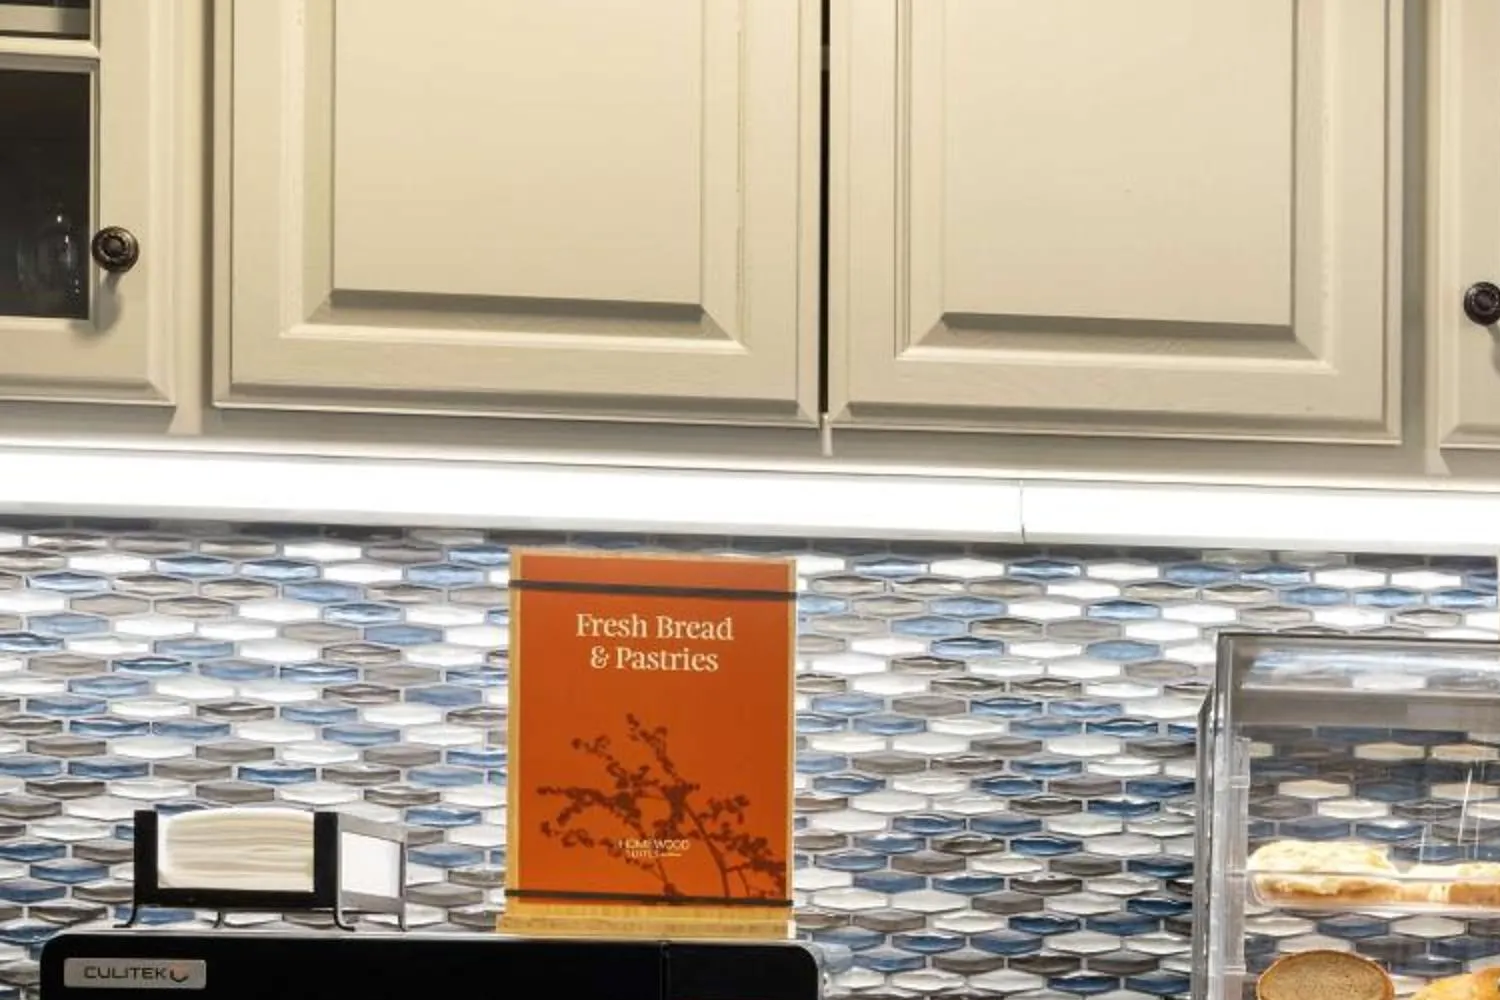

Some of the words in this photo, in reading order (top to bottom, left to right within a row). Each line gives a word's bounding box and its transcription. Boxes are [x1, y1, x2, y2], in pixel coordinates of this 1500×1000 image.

[576, 613, 648, 638] Fresh
[656, 615, 734, 641] Bread
[590, 645, 609, 669] &
[616, 646, 719, 672] Pastries
[83, 966, 167, 980] CULITEK
